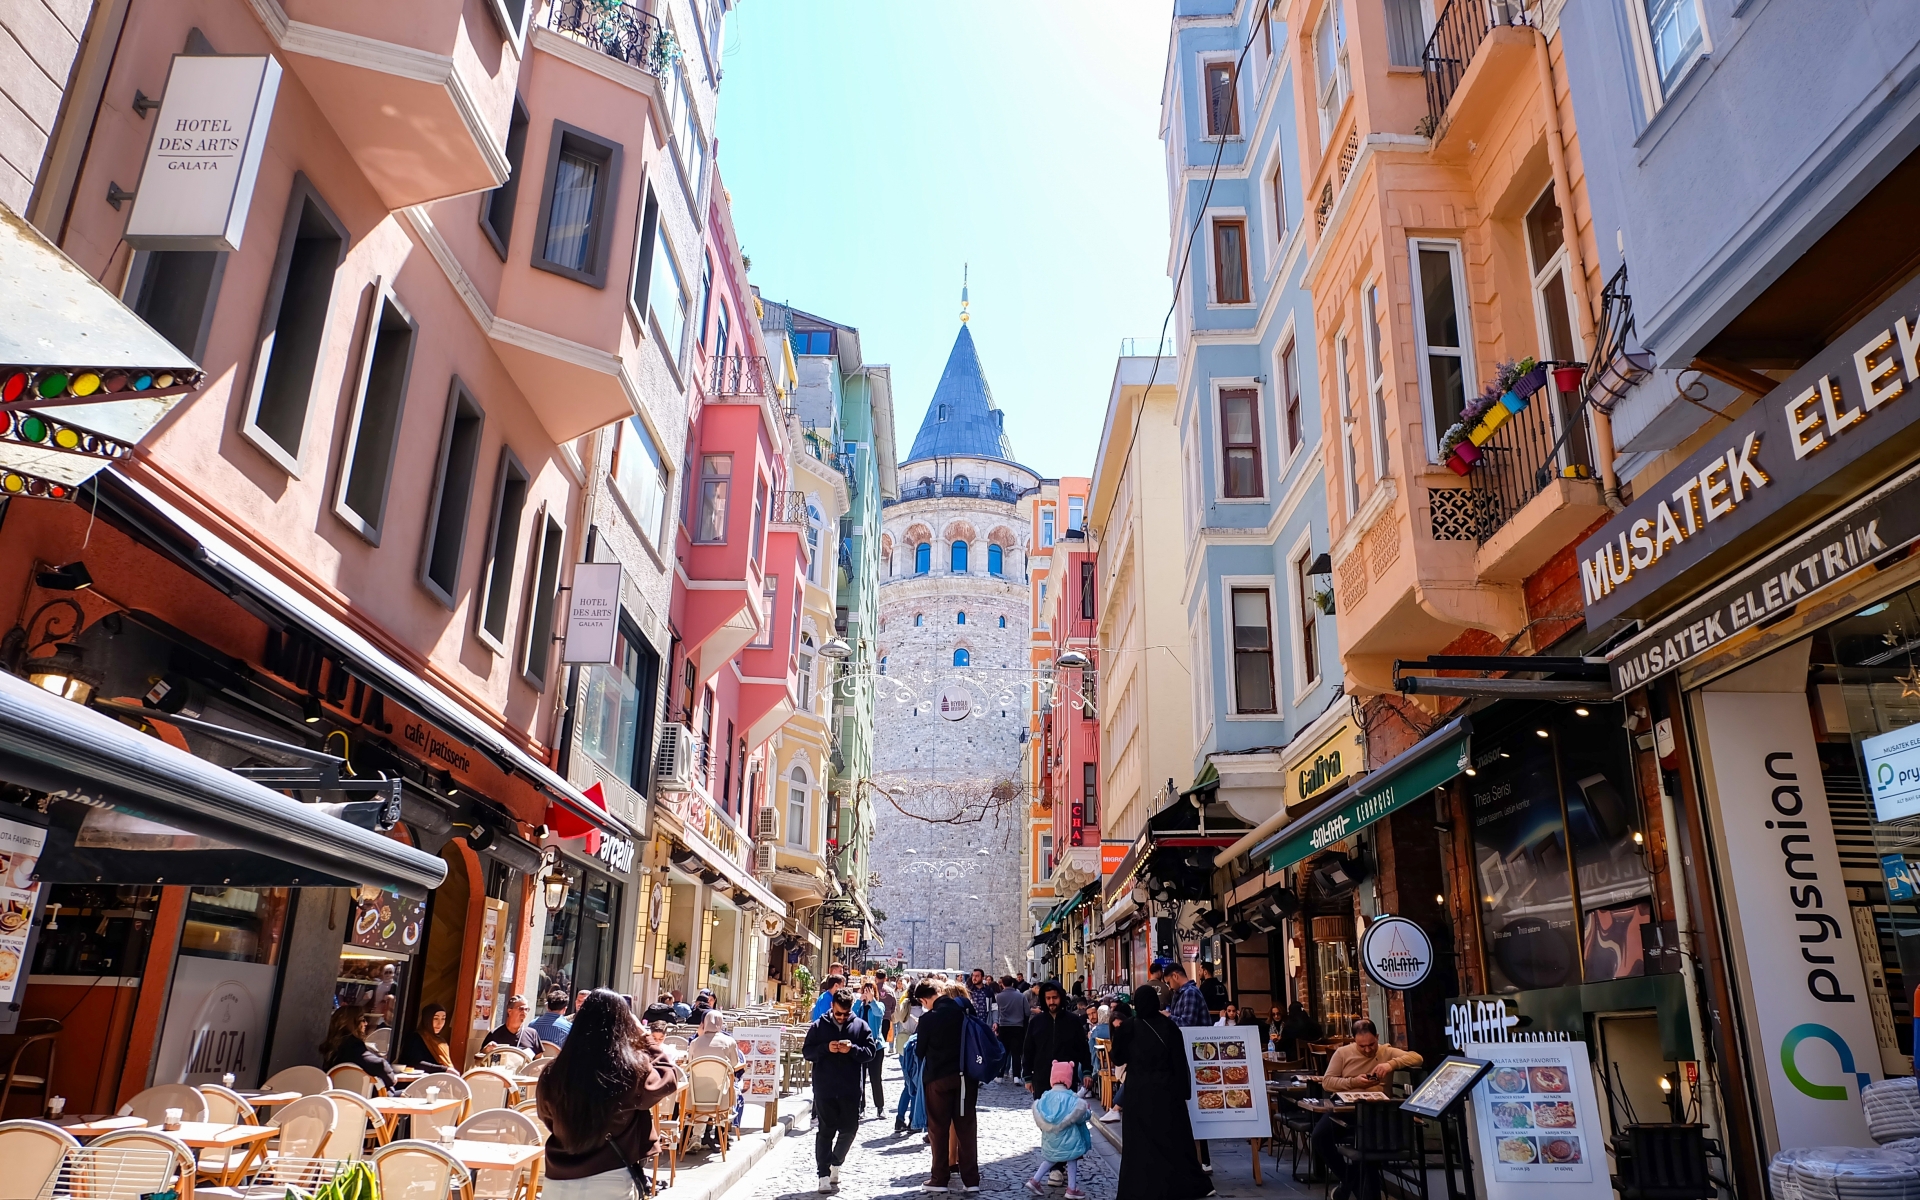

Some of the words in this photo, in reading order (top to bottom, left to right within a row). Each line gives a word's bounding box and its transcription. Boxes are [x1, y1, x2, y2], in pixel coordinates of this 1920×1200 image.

[174, 119, 232, 132] HOTEL
[158, 137, 193, 151] DES
[195, 138, 239, 151] ARTS
[168, 161, 218, 170] GALATA
[1581, 430, 1767, 606] MUSATEK
[579, 598, 608, 606] HOTEL
[1618, 609, 1726, 691] MUSATEK
[1730, 517, 1888, 630] ELEKTRİK
[590, 609, 612, 617] ARTS
[404, 723, 425, 747] cafe
[429, 741, 471, 774] patisserie
[1883, 741, 1910, 754] MUSATEK
[1474, 792, 1492, 808] Thea
[1309, 815, 1351, 849] GALATA
[12, 834, 41, 848] FAVORITES
[599, 831, 635, 875] arçelik
[1764, 752, 1856, 1003] prysmian
[1377, 957, 1426, 972] GALATA
[220, 993, 238, 1003] coffee
[1688, 1068, 1695, 1077] 21
